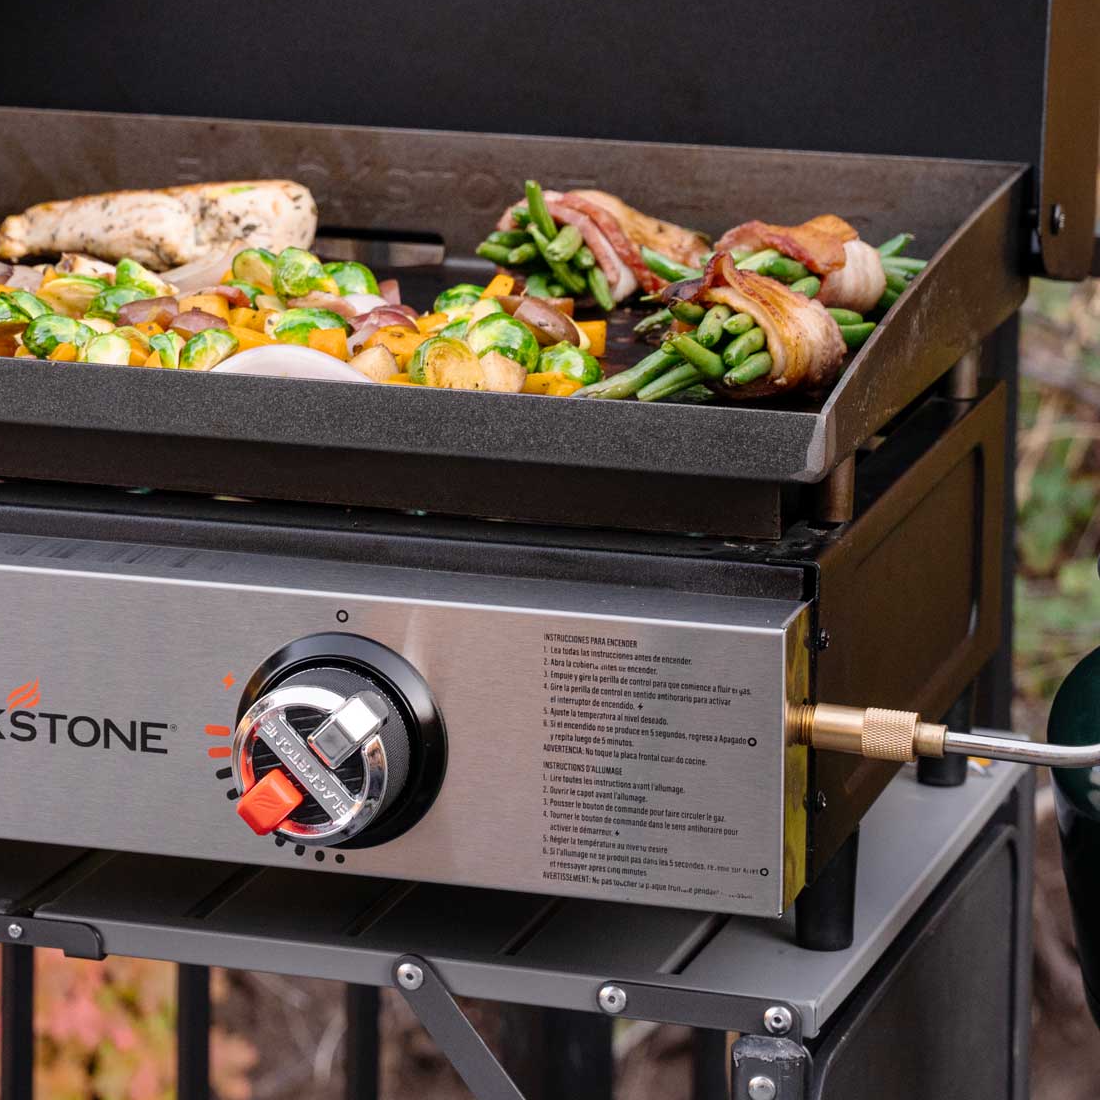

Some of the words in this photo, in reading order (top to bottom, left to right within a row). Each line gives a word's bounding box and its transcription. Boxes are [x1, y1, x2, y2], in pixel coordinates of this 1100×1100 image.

[543, 634, 589, 644] INSTRUCCIONES
[590, 637, 606, 645] PARA
[606, 638, 638, 648] ENCENDER
[550, 646, 561, 654] Lea
[591, 651, 633, 660] instrucciones
[550, 659, 565, 667] Abra
[550, 671, 573, 680] Empuje
[599, 676, 619, 684] perilla
[550, 683, 563, 691] Gire
[709, 698, 732, 706] activar
[557, 697, 591, 706] interruptor
[550, 708, 569, 717] Ajuste
[564, 723, 596, 731] encendido
[614, 727, 640, 735] produce
[719, 735, 747, 745] Apagado
[574, 734, 592, 744] luego
[595, 749, 612, 758] toque
[620, 751, 637, 759] placa
[638, 752, 660, 761] frontal
[543, 761, 585, 772] INSTRUCTIONS
[563, 776, 582, 784] toutes
[583, 777, 592, 785] les
[549, 798, 575, 807] Pousser
[582, 802, 605, 810] bouton
[614, 806, 648, 815] commande
[665, 809, 680, 817] faire
[681, 812, 705, 820] circuler
[549, 811, 573, 820] Tourner
[581, 814, 603, 822] bouton
[613, 818, 647, 827] commande
[648, 820, 664, 828] dans
[549, 824, 571, 832] activer
